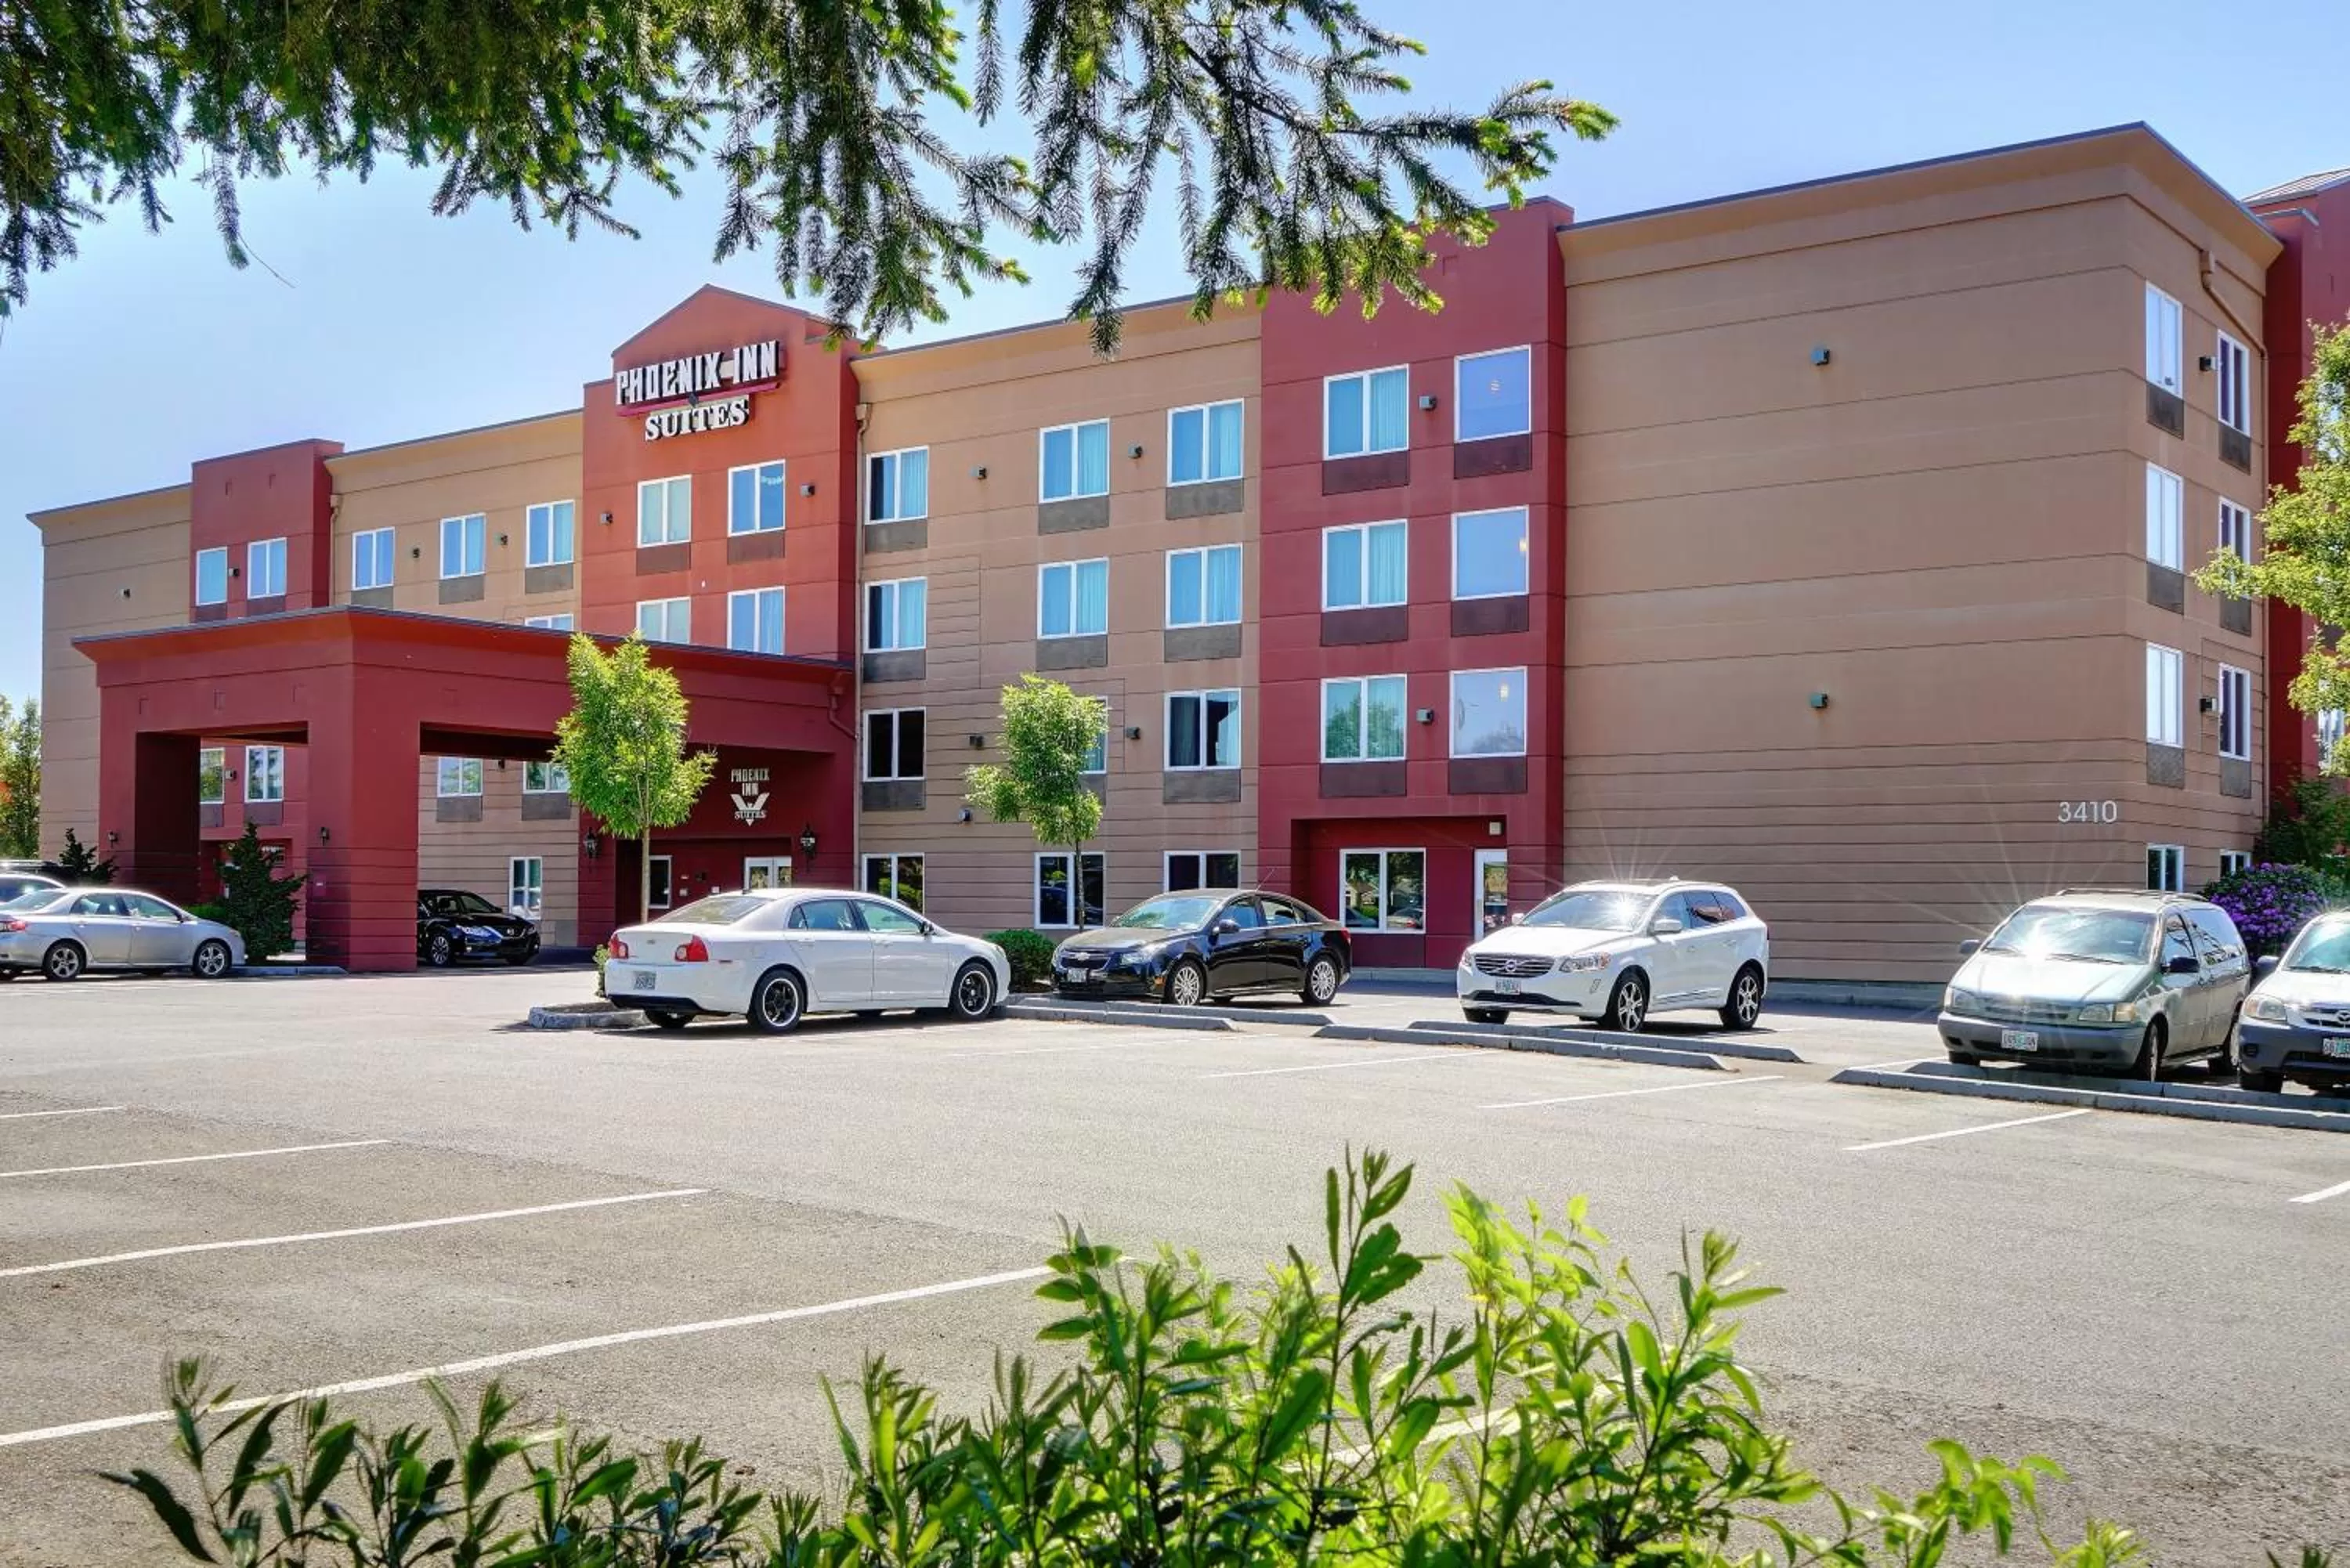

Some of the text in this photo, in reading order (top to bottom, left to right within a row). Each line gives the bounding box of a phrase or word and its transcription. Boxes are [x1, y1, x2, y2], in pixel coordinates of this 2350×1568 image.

[616, 339, 777, 405] PHOENIX INN
[645, 399, 750, 441] SUITES
[731, 768, 770, 782] PHOENIX
[2057, 800, 2117, 823] 3410
